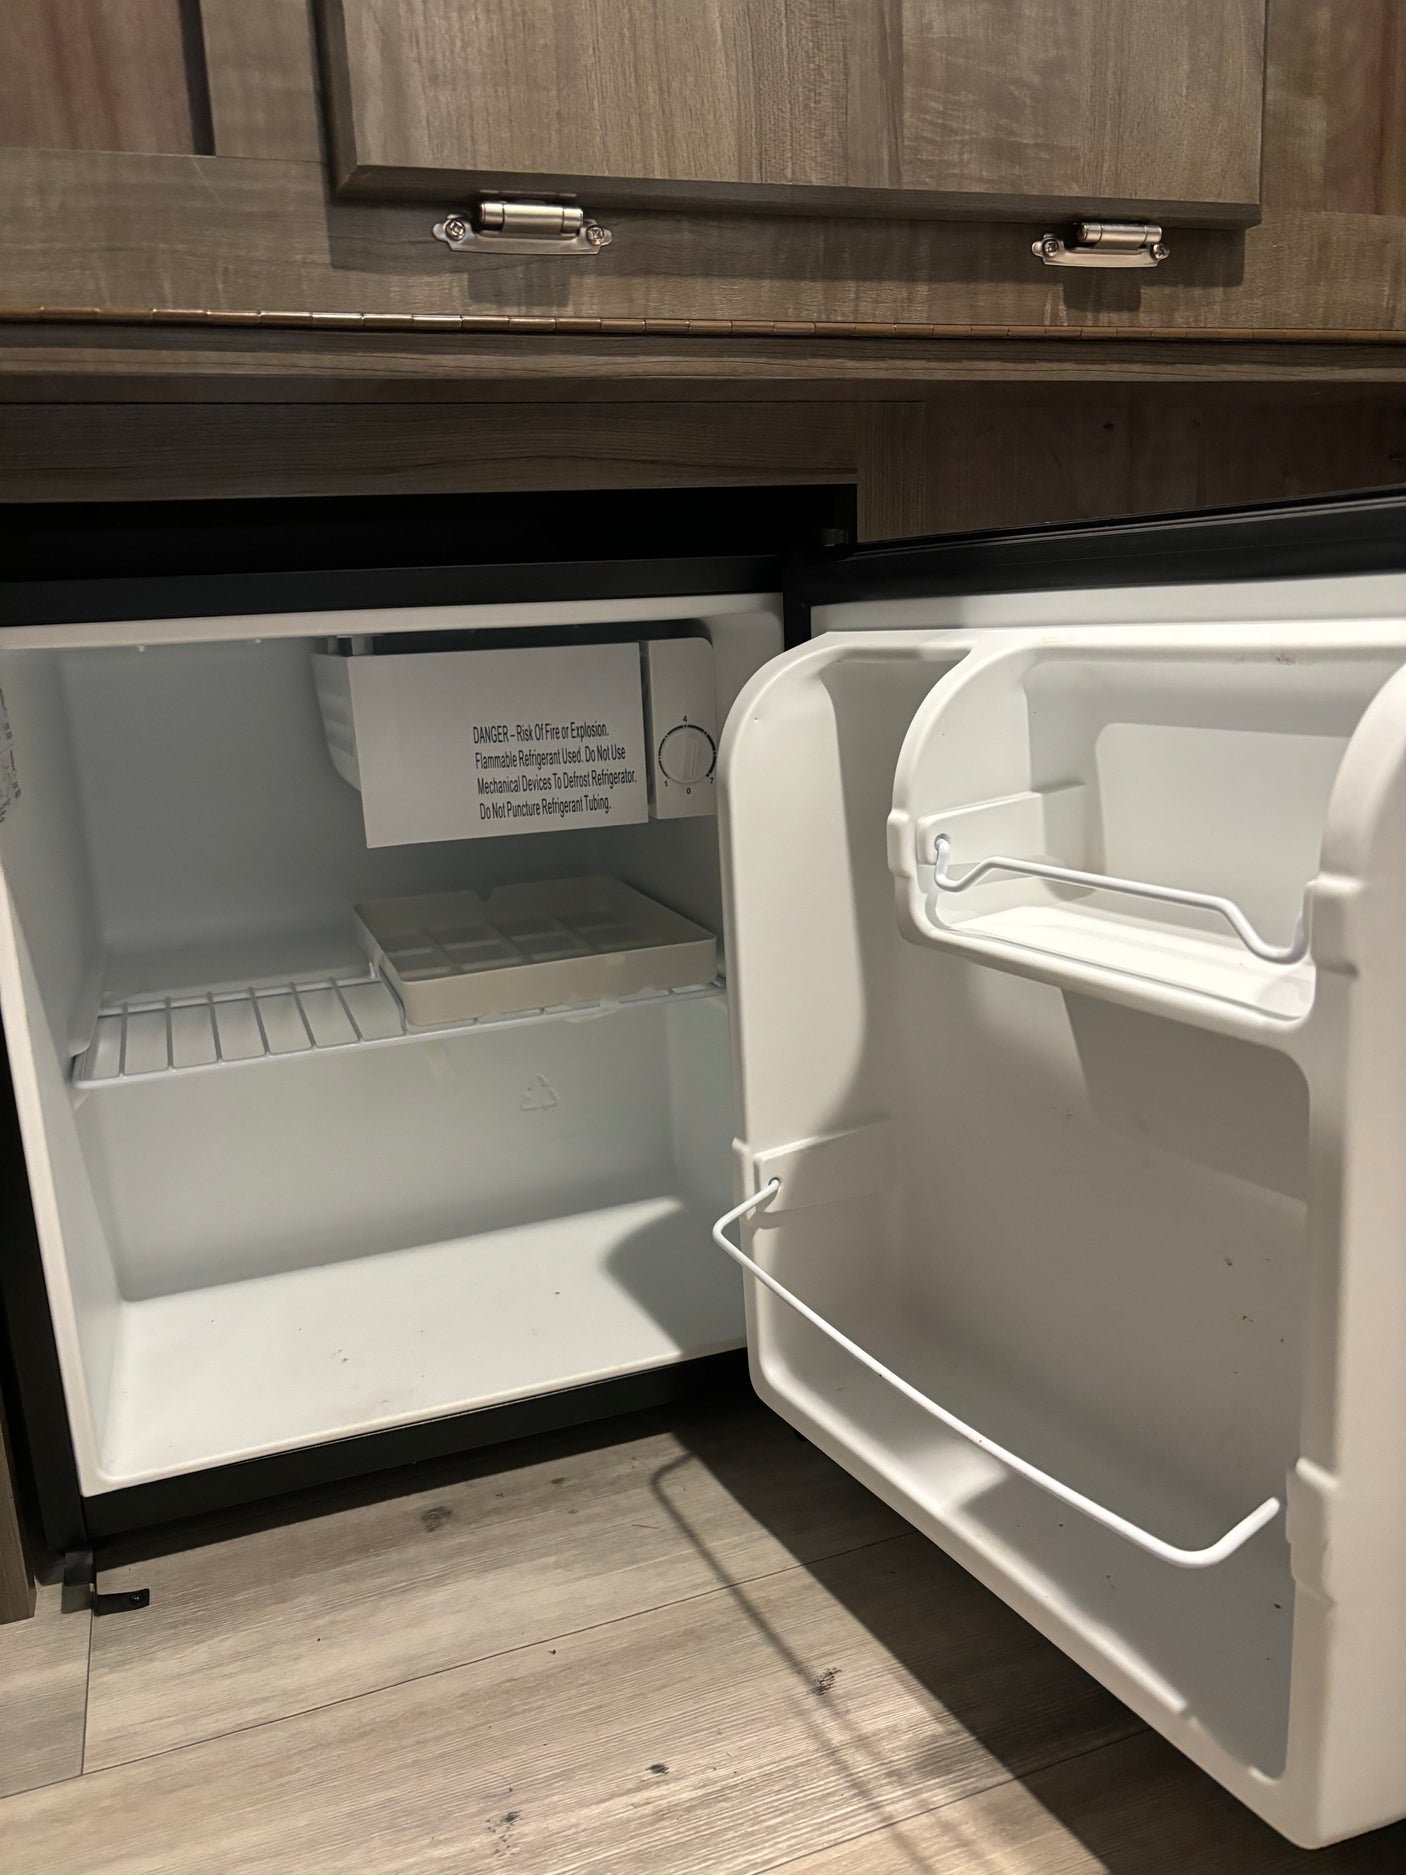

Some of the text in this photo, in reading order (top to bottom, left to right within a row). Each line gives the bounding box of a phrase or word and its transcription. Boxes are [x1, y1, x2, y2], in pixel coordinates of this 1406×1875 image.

[473, 725, 509, 744] DANGER
[516, 724, 533, 741] Risk
[535, 724, 543, 740] Of
[545, 723, 559, 739] Fire
[561, 726, 569, 739] or
[570, 722, 609, 741] Explosion.
[475, 746, 626, 769] Flammable Refrigerant Used. Do Not Use
[477, 769, 637, 794] Mechanical Devices To Defrost Refrigerator.
[480, 795, 611, 820] Do Not Puncture Refrigerant Tubing.
